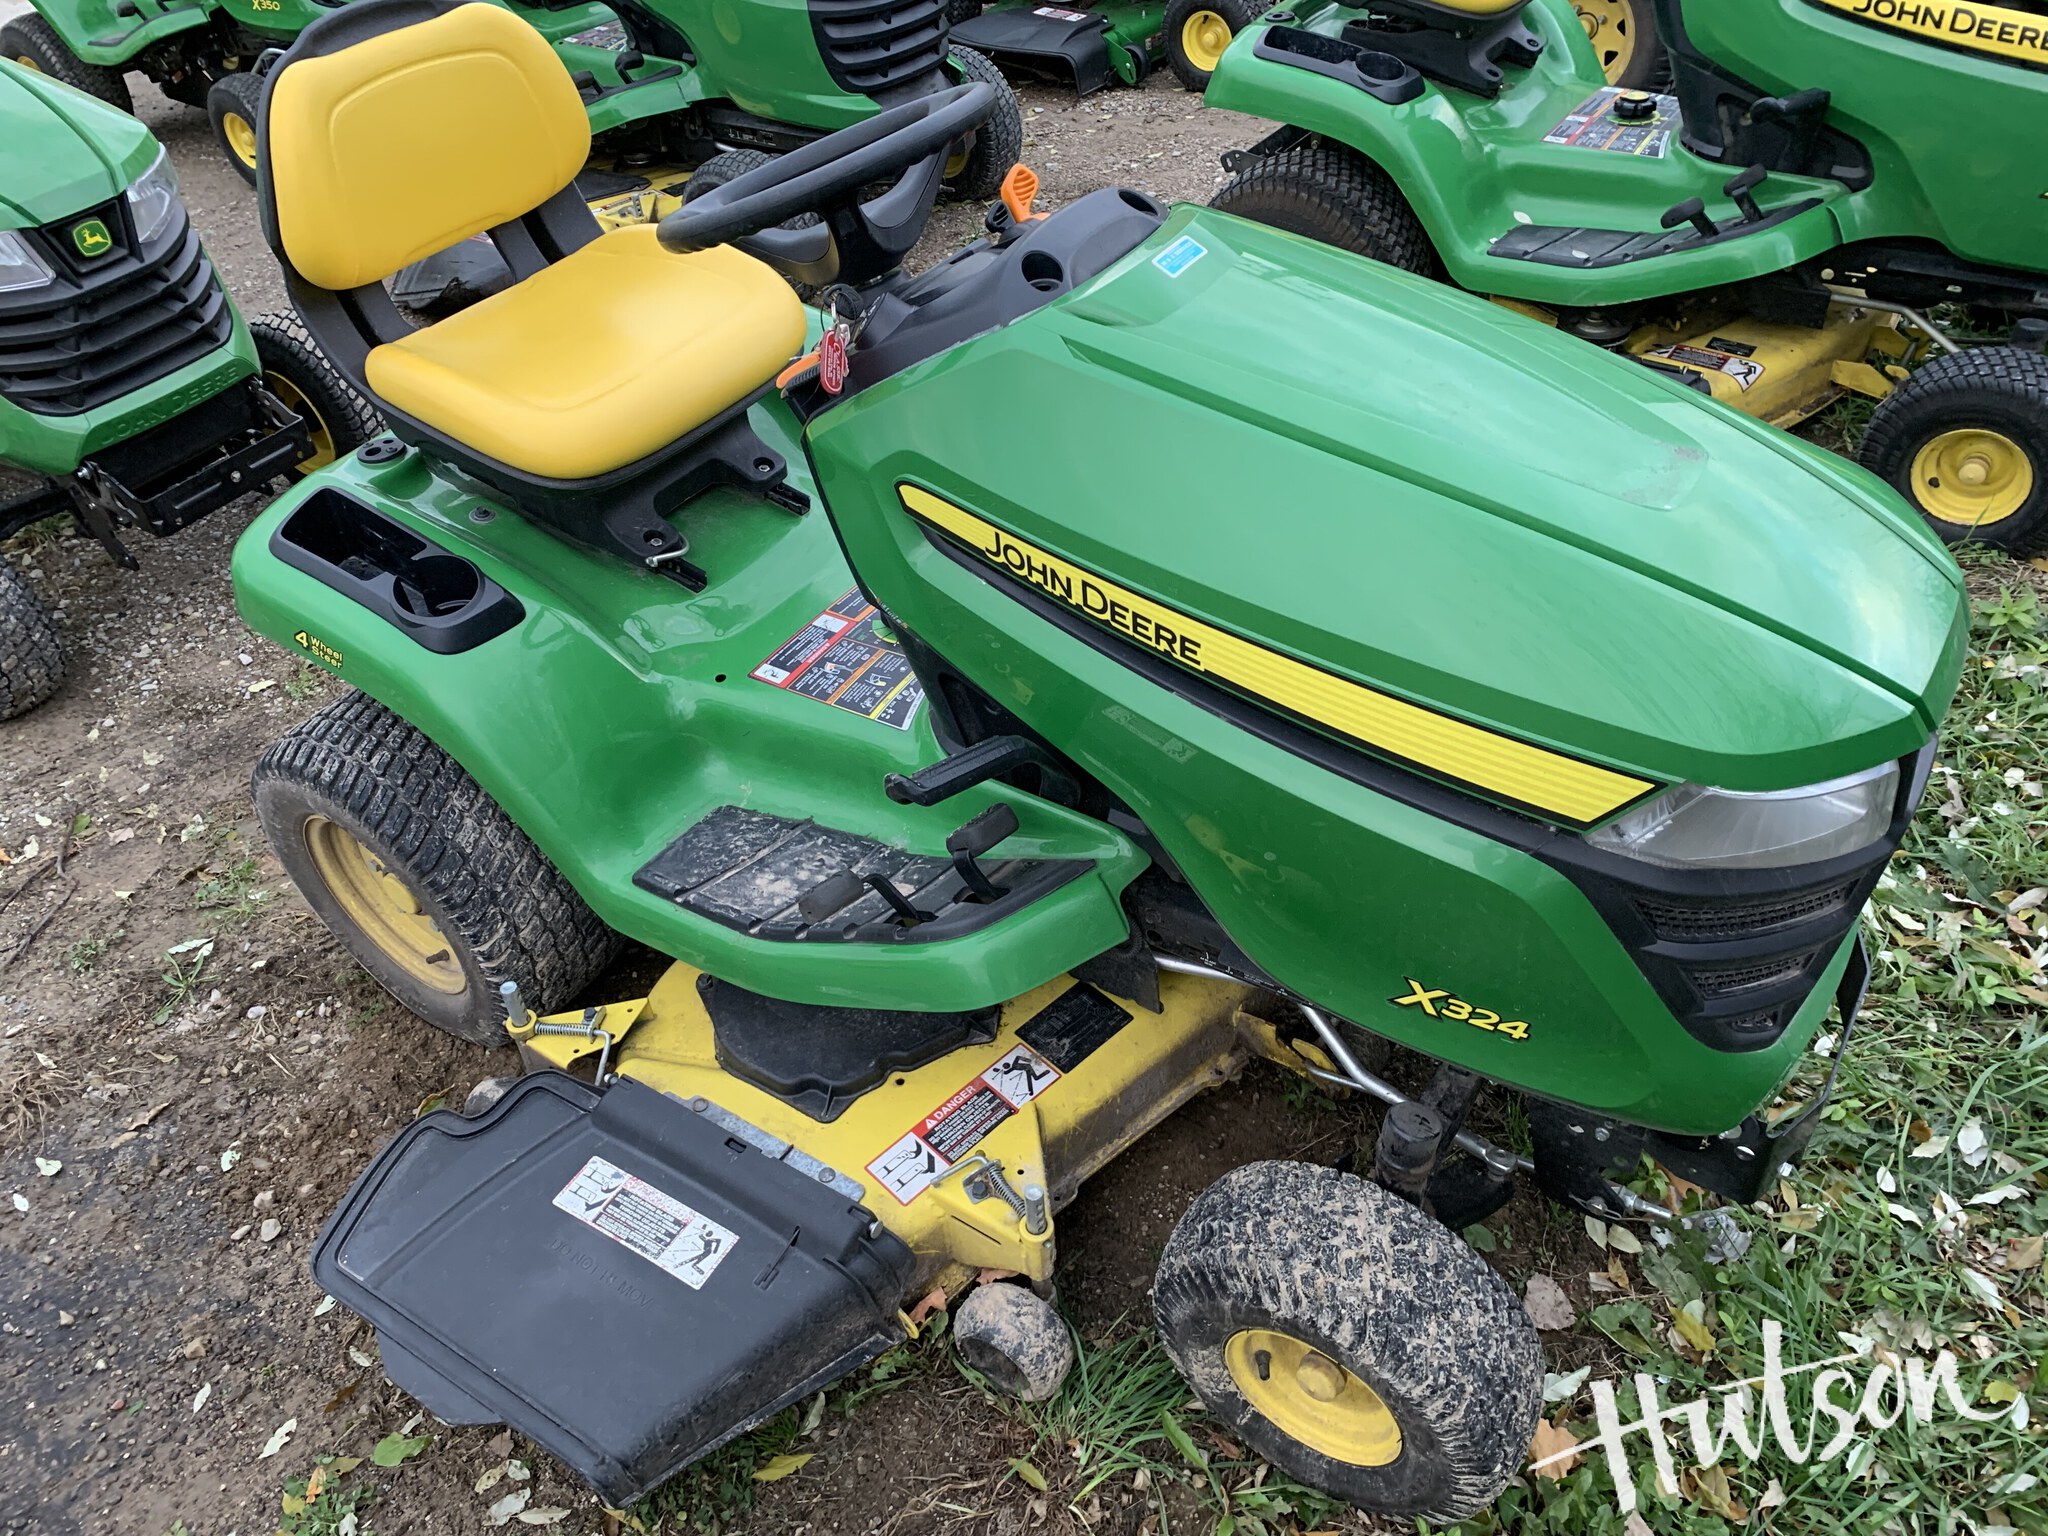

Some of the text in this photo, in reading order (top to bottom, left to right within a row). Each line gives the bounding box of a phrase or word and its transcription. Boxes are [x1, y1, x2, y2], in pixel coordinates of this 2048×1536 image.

[253, 0, 280, 11] X350
[1853, 0, 1945, 29] JOHN
[172, 366, 240, 413] DEERE
[985, 531, 1202, 666] JOHN DEERE
[295, 630, 343, 662] 4 Wheel
[311, 646, 343, 669] Steer
[1390, 975, 1531, 1041] X324
[933, 1085, 976, 1120] DANGER
[934, 1095, 978, 1131] ROTATING BLADE
[942, 1102, 989, 1141] THROWN OBJECTS
